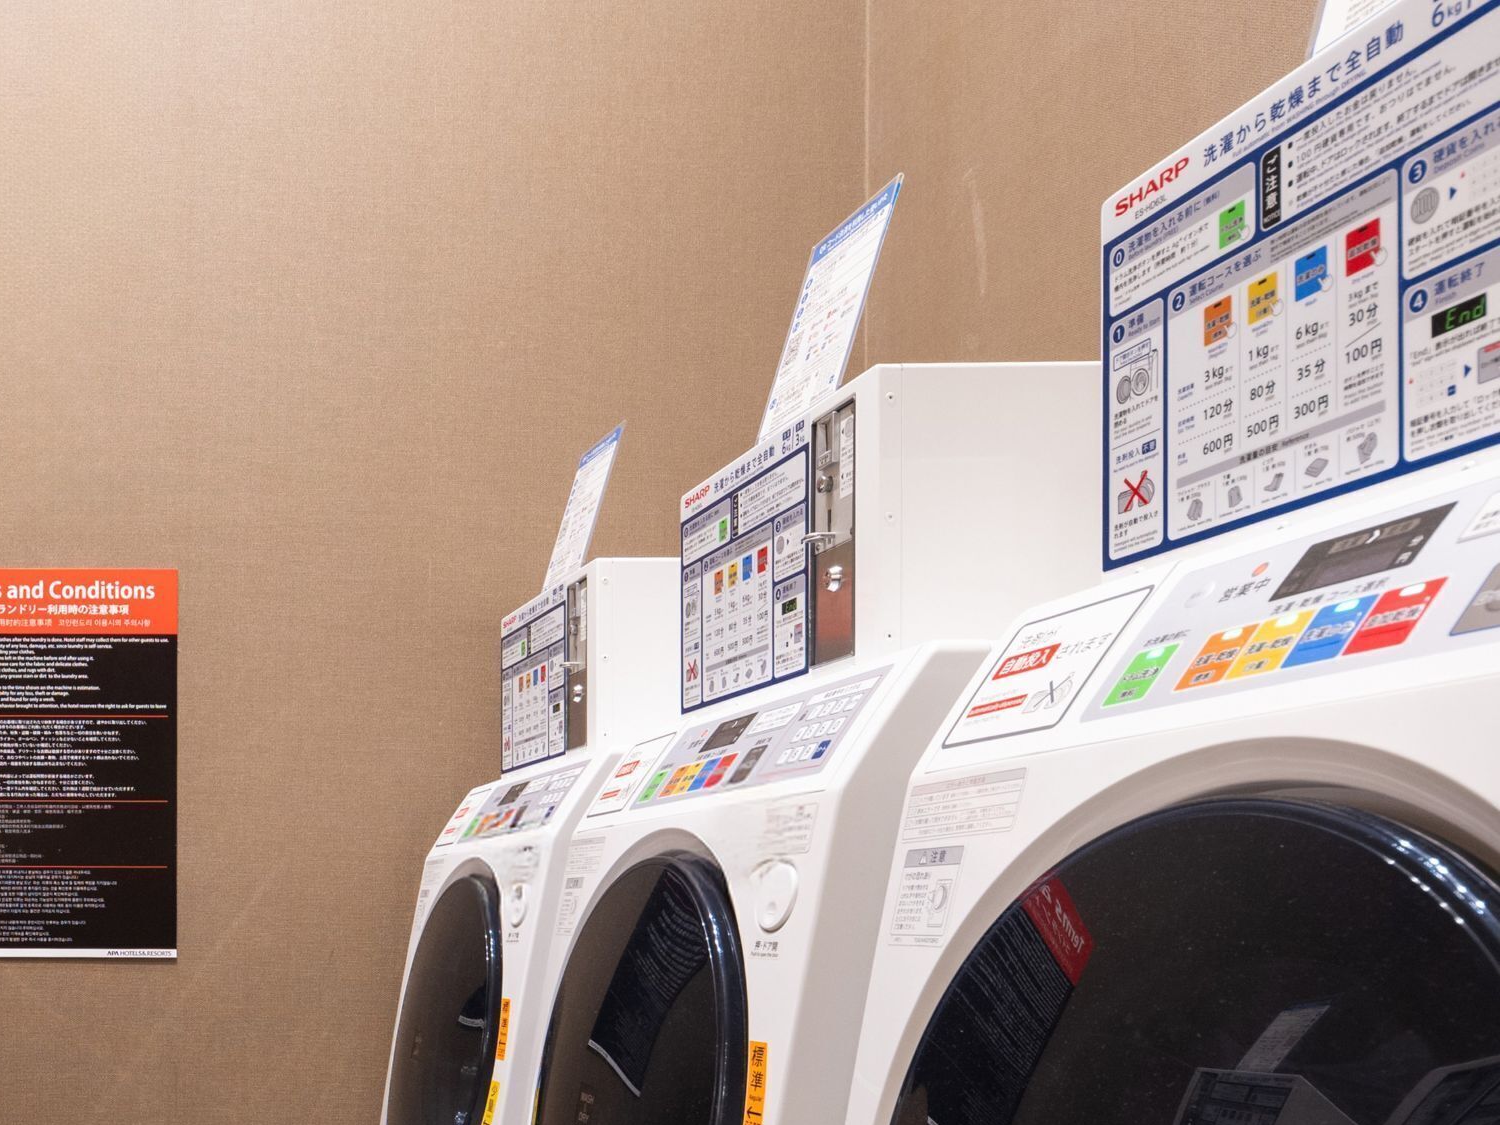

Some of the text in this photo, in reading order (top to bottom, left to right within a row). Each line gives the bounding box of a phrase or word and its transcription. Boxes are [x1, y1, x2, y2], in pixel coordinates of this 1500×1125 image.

[1430, 2, 1463, 28] 6kg
[1202, 21, 1405, 167] 洗濯から乾燥まで全自動
[1265, 154, 1279, 210] ご注意
[1411, 162, 1425, 182] 3
[1114, 156, 1190, 218] SHARP
[1128, 201, 1202, 251] 洗濯物を入れる前に
[1189, 249, 1263, 298] 運転コースを選ぶ
[1433, 261, 1485, 296] 運転終了
[1174, 294, 1183, 310] 2
[1411, 292, 1425, 310] 4
[1128, 314, 1145, 328] 準備
[1348, 303, 1378, 327] 30分
[1444, 297, 1486, 331] End
[1295, 322, 1319, 340] 6kg
[1249, 345, 1269, 361] 1kg
[1345, 338, 1382, 364] 100円
[1203, 365, 1225, 383] 3kg
[1297, 358, 1326, 381] 35分
[1250, 379, 1276, 401] 80分
[1203, 398, 1233, 420] 120分
[1294, 394, 1329, 419] 300円
[1247, 414, 1279, 438] 500円
[1115, 447, 1141, 465] 洗剤投入
[1203, 433, 1233, 456] 600円
[684, 485, 710, 508] SHARP
[7, 580, 44, 599] and
[49, 580, 155, 599] Conditions
[1218, 578, 1273, 603] 営業中
[998, 647, 1051, 675] 自動投入
[751, 1046, 765, 1091] 標準
